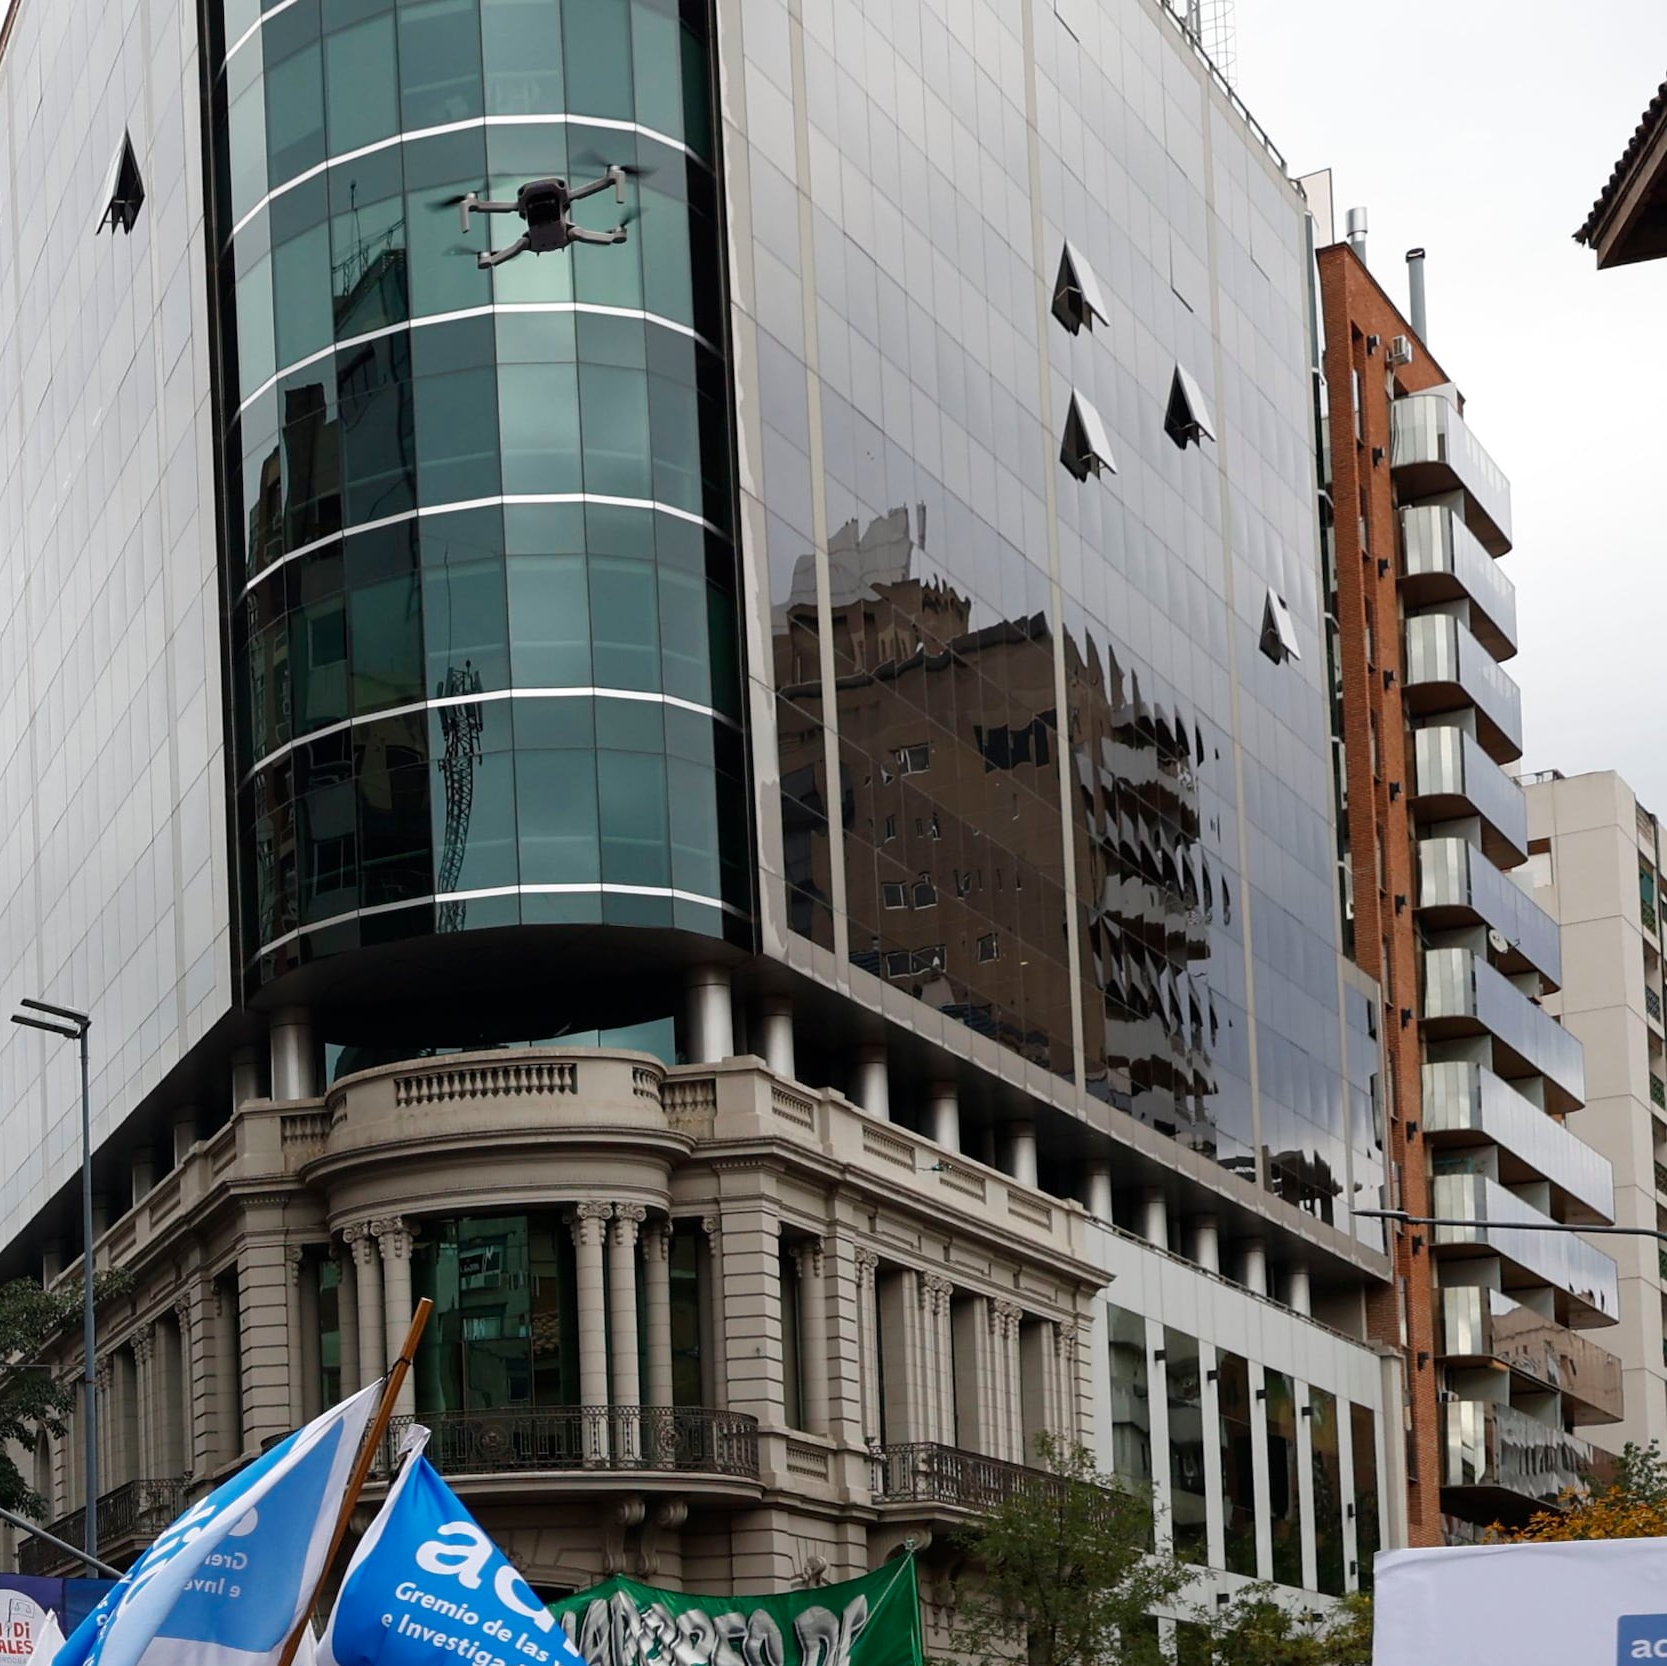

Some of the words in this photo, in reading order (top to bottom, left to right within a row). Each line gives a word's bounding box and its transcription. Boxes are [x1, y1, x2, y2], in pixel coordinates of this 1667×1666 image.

[381, 1613, 394, 1628] e
[395, 1581, 479, 1626] Gremio
[482, 1619, 513, 1643] de
[515, 1633, 549, 1662] las
